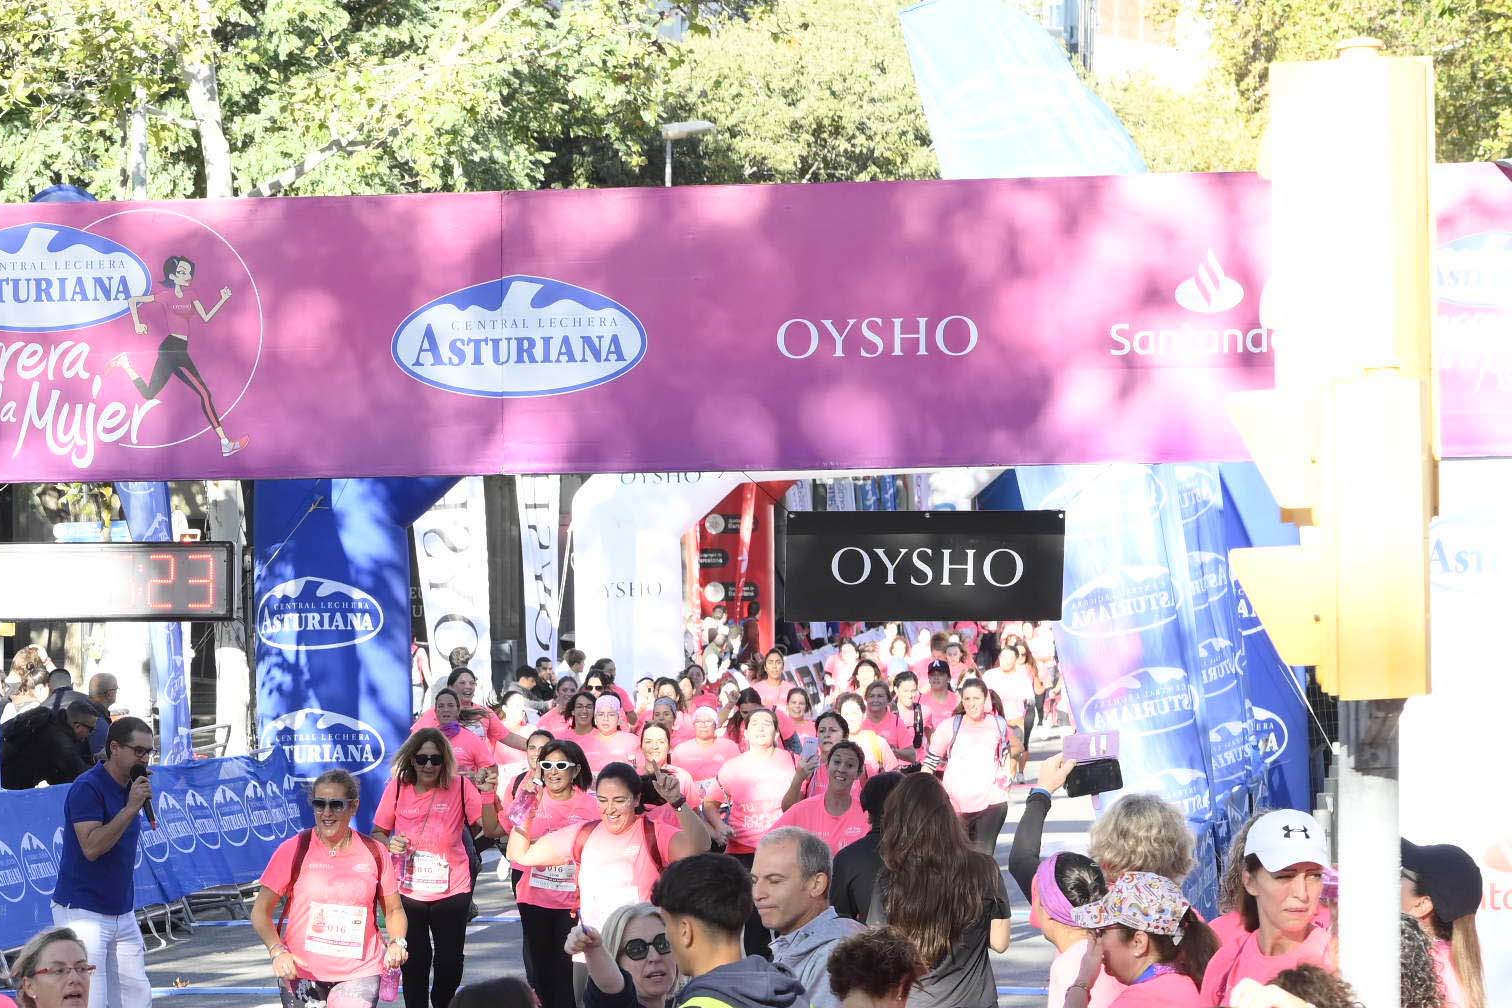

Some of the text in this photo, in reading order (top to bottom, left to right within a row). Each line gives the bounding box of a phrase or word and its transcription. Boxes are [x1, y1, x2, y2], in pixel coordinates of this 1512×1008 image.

[55, 259, 126, 270] LECHERA
[451, 316, 619, 330] CENTRAL LECHERA
[777, 315, 979, 359] OYSHO
[411, 322, 628, 367] ASTURIANA
[1110, 323, 1269, 356] Sanand
[13, 374, 162, 469] Mujer
[830, 546, 1025, 588] OYSHO
[600, 580, 663, 599] YSHO
[261, 606, 375, 634] ASTURIANA
[285, 744, 376, 763] TURIANA
